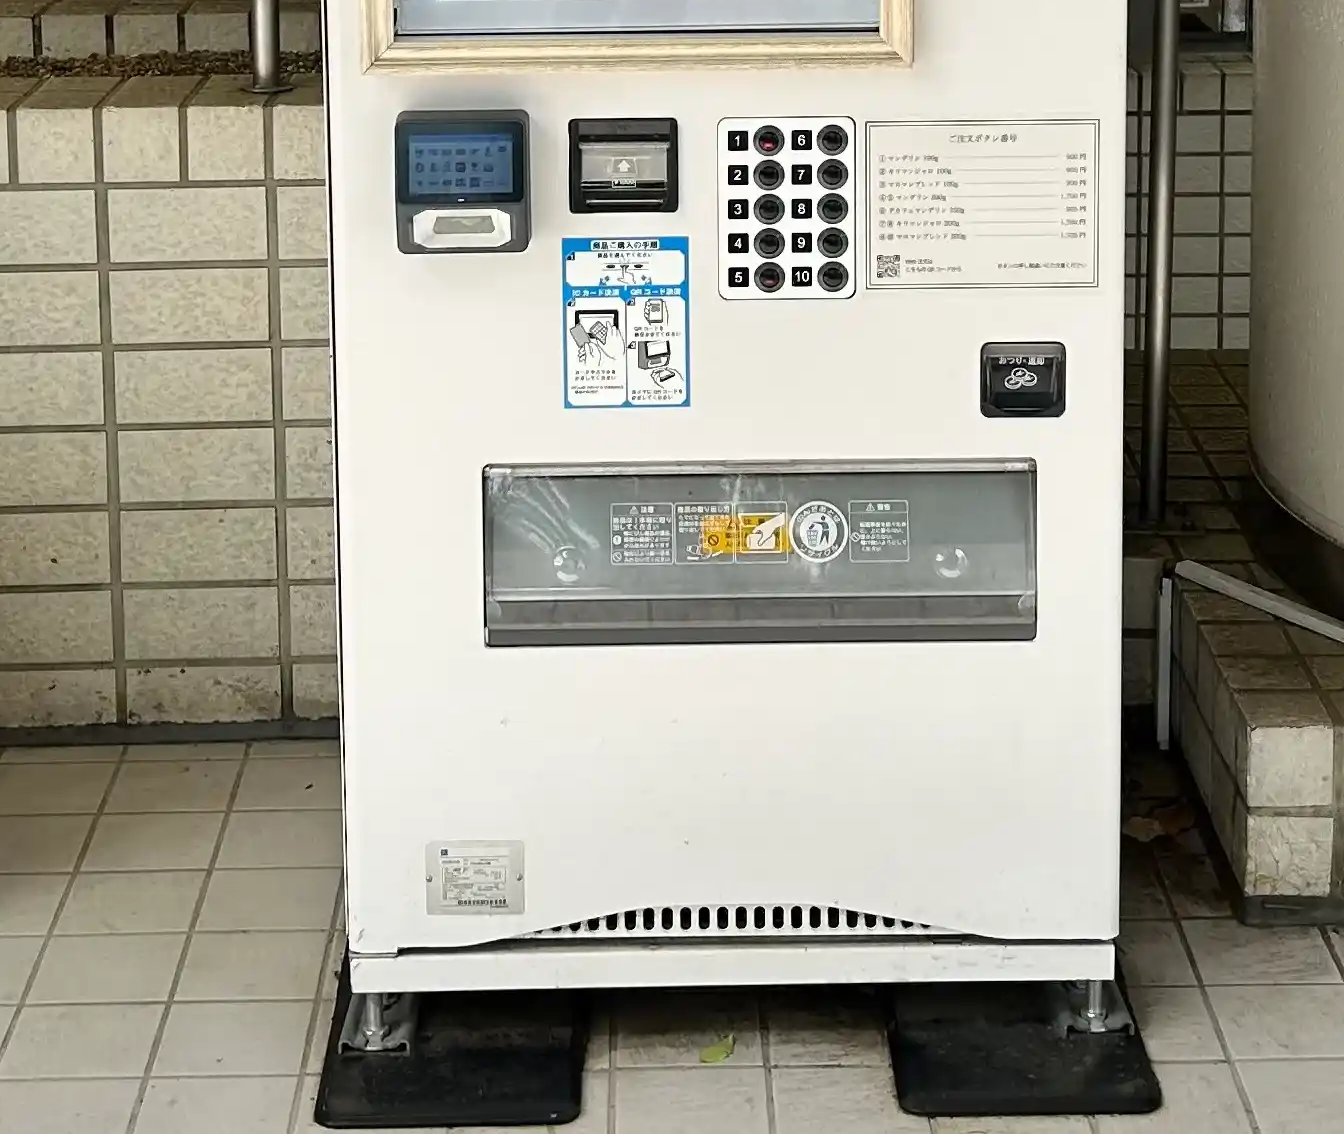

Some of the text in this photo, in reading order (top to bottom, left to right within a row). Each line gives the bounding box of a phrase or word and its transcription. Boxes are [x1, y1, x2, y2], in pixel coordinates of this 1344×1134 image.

[734, 135, 741, 147] 1
[797, 135, 806, 147] 6
[733, 169, 742, 181] 2
[797, 169, 805, 181] 7
[733, 203, 742, 215] 3
[797, 203, 806, 215] 8
[734, 237, 742, 249] 4
[797, 237, 806, 249] 9
[734, 271, 743, 283] 5
[795, 271, 810, 283] 10
